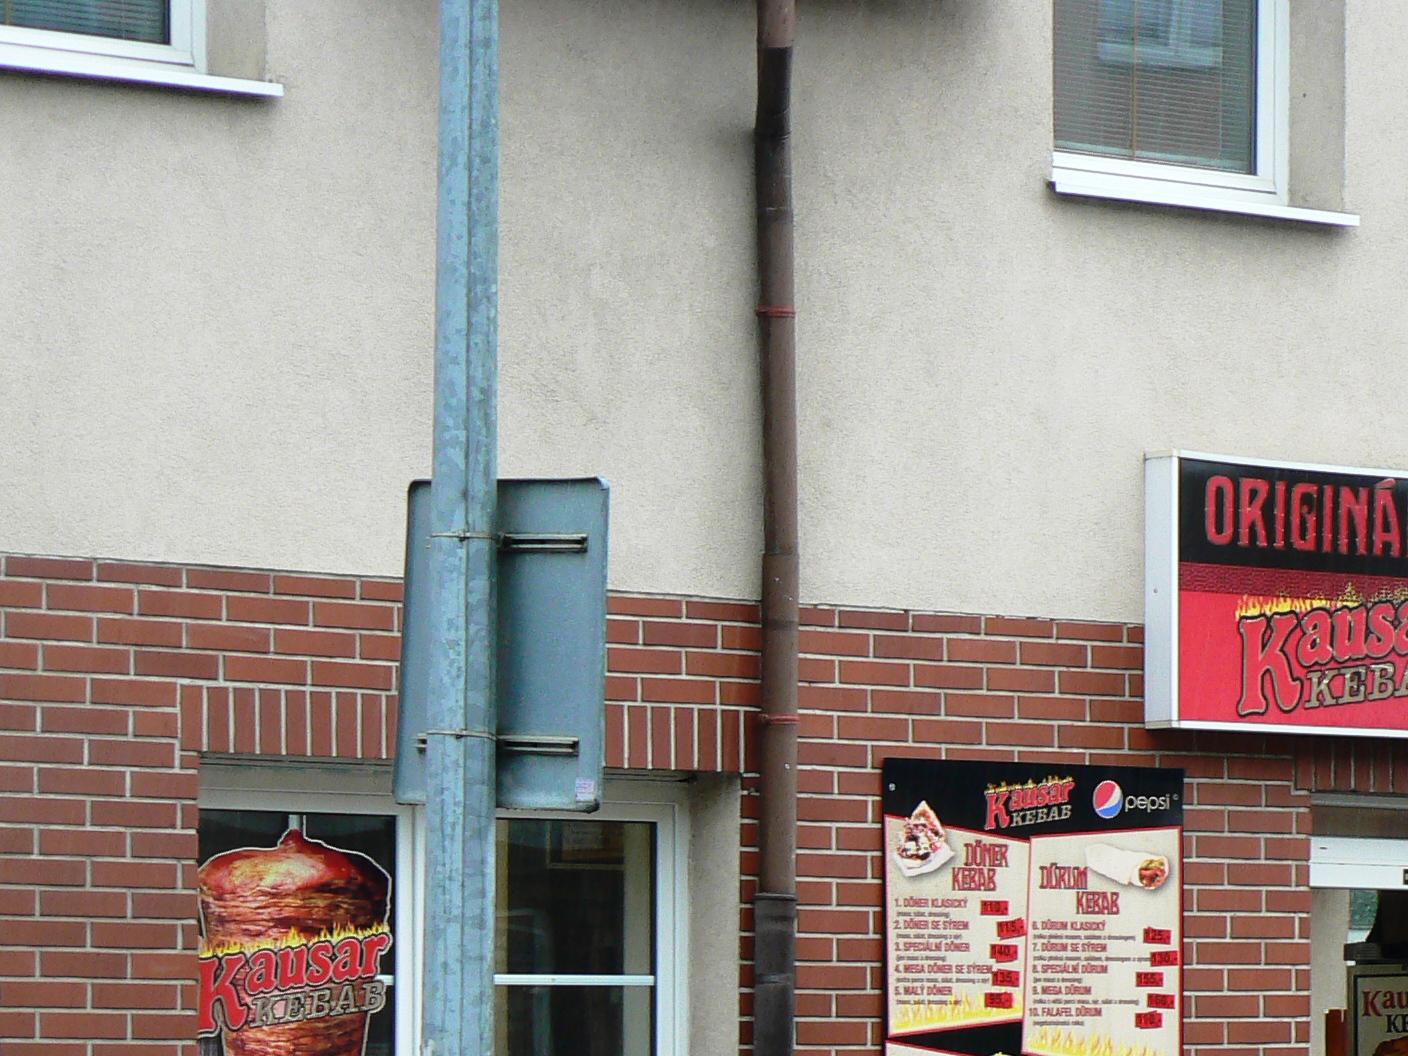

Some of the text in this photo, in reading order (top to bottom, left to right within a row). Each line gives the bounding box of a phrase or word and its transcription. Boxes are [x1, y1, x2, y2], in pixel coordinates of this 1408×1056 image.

[984, 781, 1076, 830] Kausar
[1010, 804, 1072, 827] KEBAB
[1124, 793, 1171, 813] pepsi
[964, 840, 1009, 867] DÖNER
[952, 866, 997, 891] KEBAB
[1039, 862, 1089, 889] DÜRUM
[1076, 891, 1120, 915] KEBAB
[198, 933, 390, 1036] Kausar
[250, 981, 386, 1028] KEBAB
